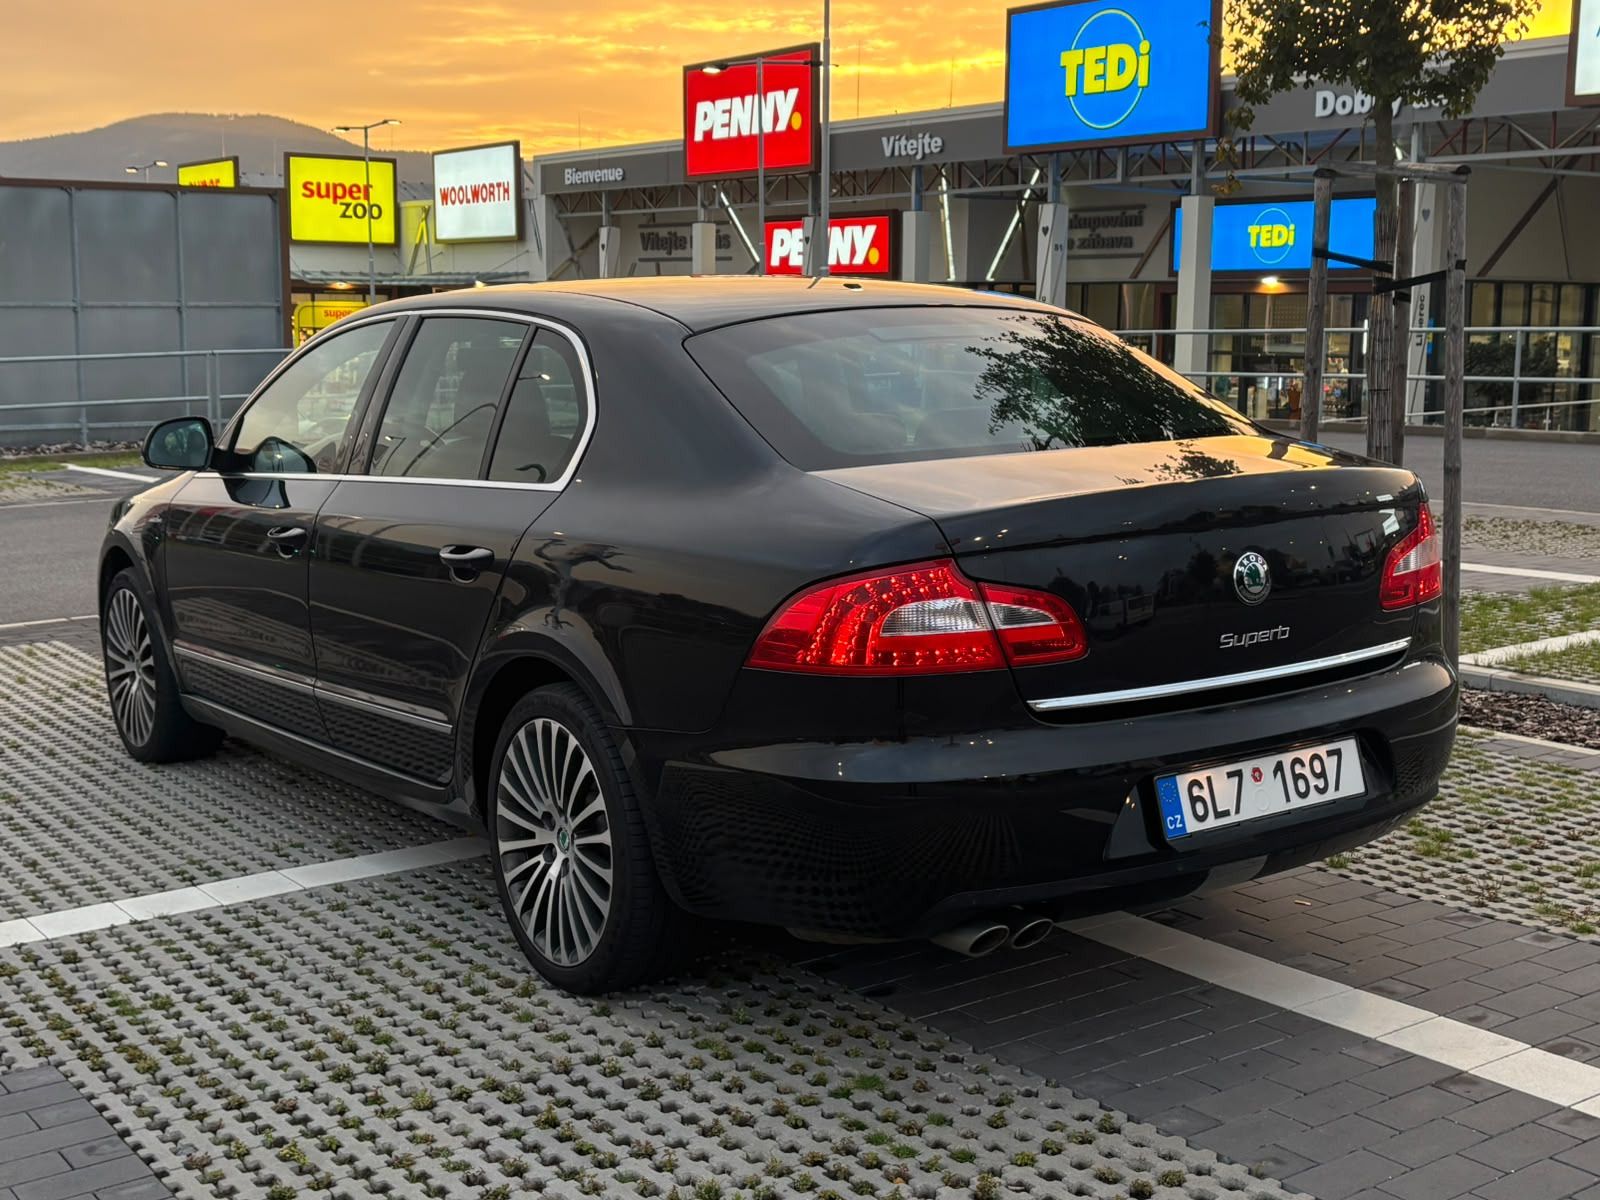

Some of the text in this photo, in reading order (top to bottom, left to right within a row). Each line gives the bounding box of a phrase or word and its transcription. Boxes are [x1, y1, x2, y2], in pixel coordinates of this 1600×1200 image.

[1060, 40, 1150, 96] TEDi
[881, 133, 943, 160] Vítejte
[564, 168, 624, 185] Bienvenue
[302, 181, 373, 204] super
[440, 181, 509, 206] WOOLWORTH
[339, 202, 382, 219] zoo
[1248, 224, 1296, 248] TEDi
[1220, 625, 1290, 648] Superb
[1187, 747, 1343, 823] 6L7 1697
[1167, 814, 1183, 830] CZ
